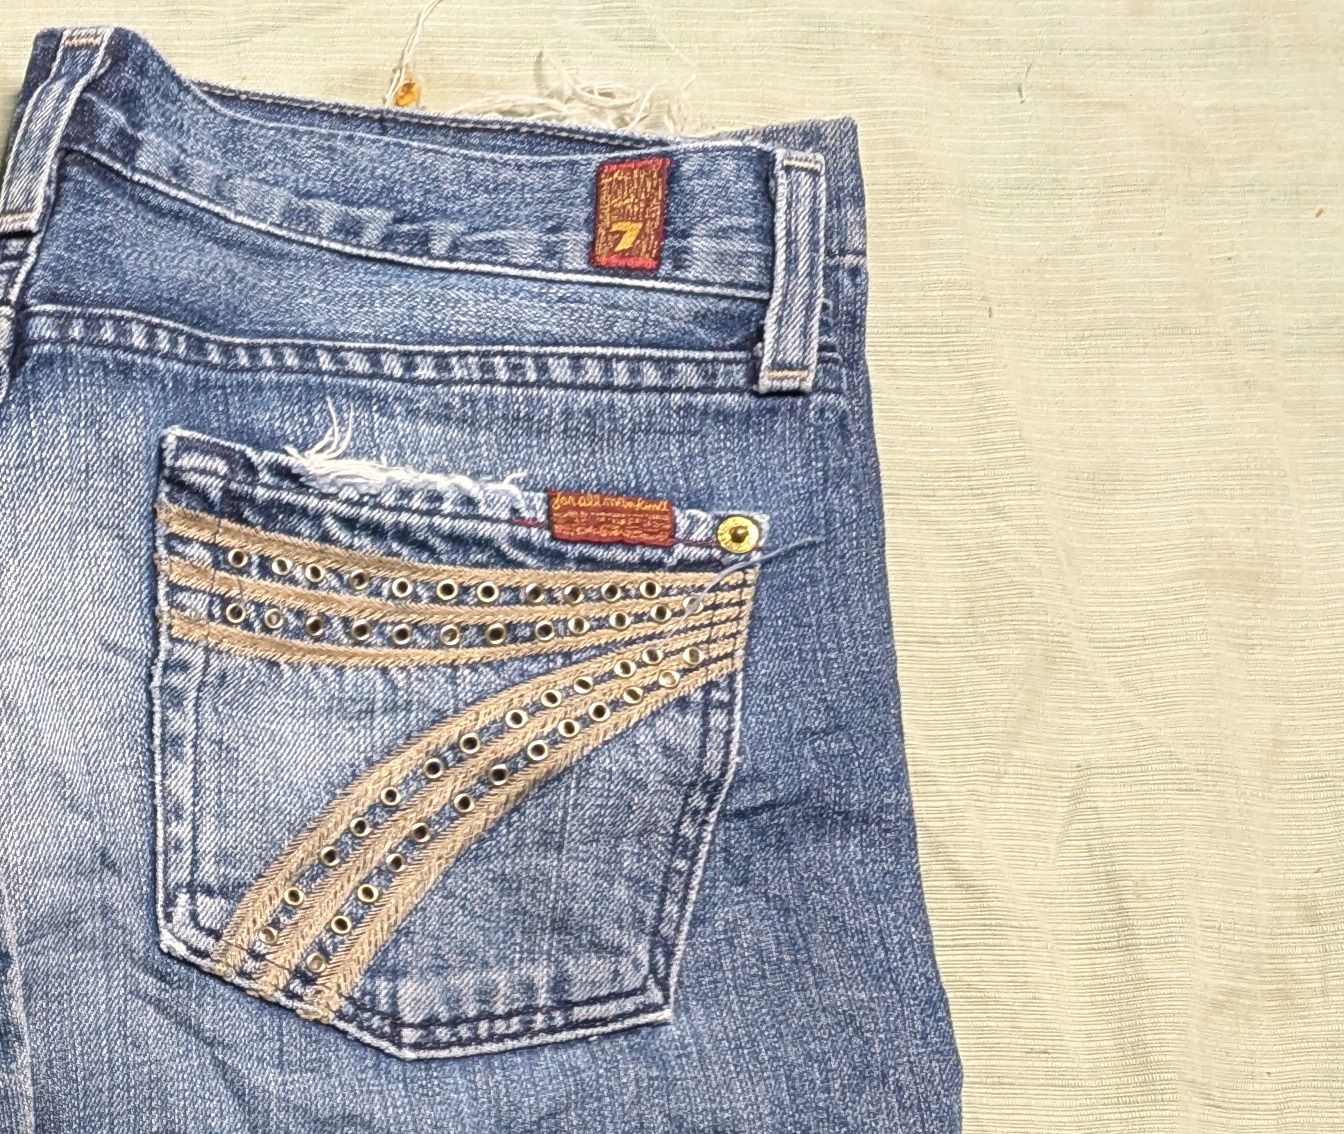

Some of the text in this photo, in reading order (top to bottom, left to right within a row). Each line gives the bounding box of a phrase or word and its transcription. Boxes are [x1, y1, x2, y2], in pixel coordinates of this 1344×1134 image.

[611, 221, 644, 252] 7
[553, 491, 670, 512] for all mankind
